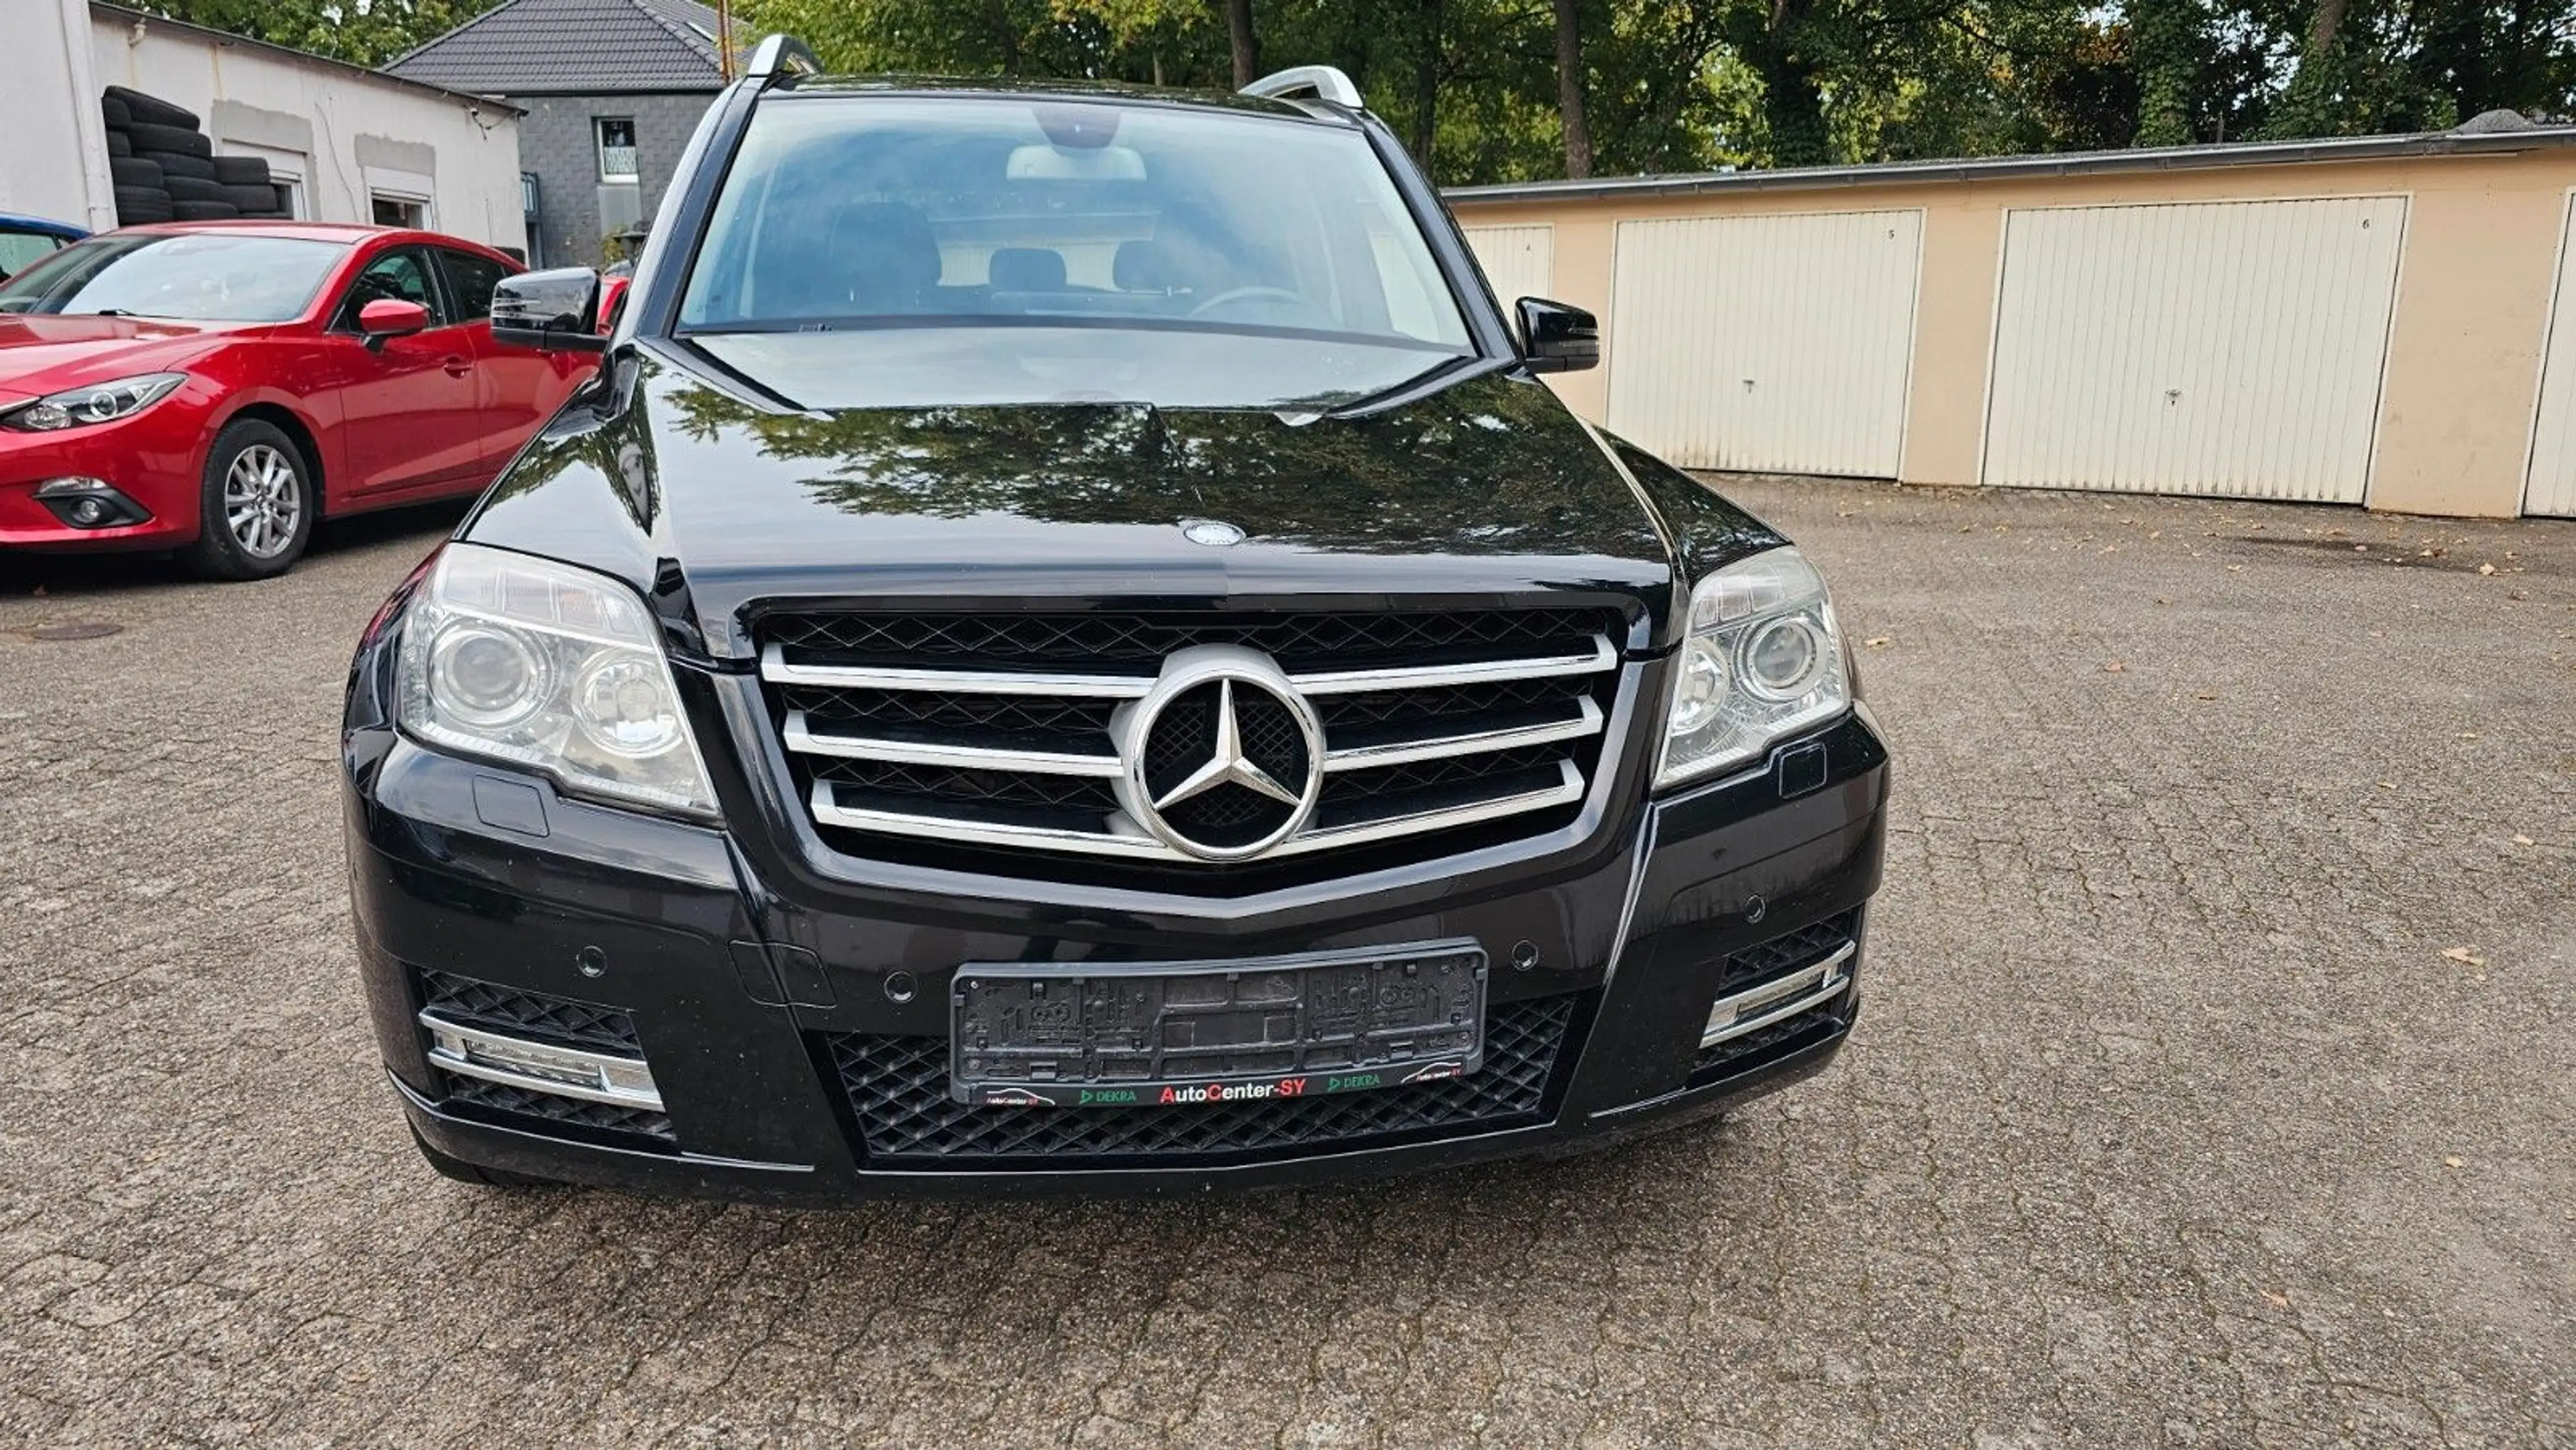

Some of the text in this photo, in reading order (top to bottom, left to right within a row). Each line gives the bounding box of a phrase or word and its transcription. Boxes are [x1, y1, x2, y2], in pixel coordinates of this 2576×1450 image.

[1344, 1075, 1381, 1088] DEKRA
[1096, 1091, 1137, 1102] DEKRA
[1160, 1078, 1306, 1103] AutoCenter-SY
